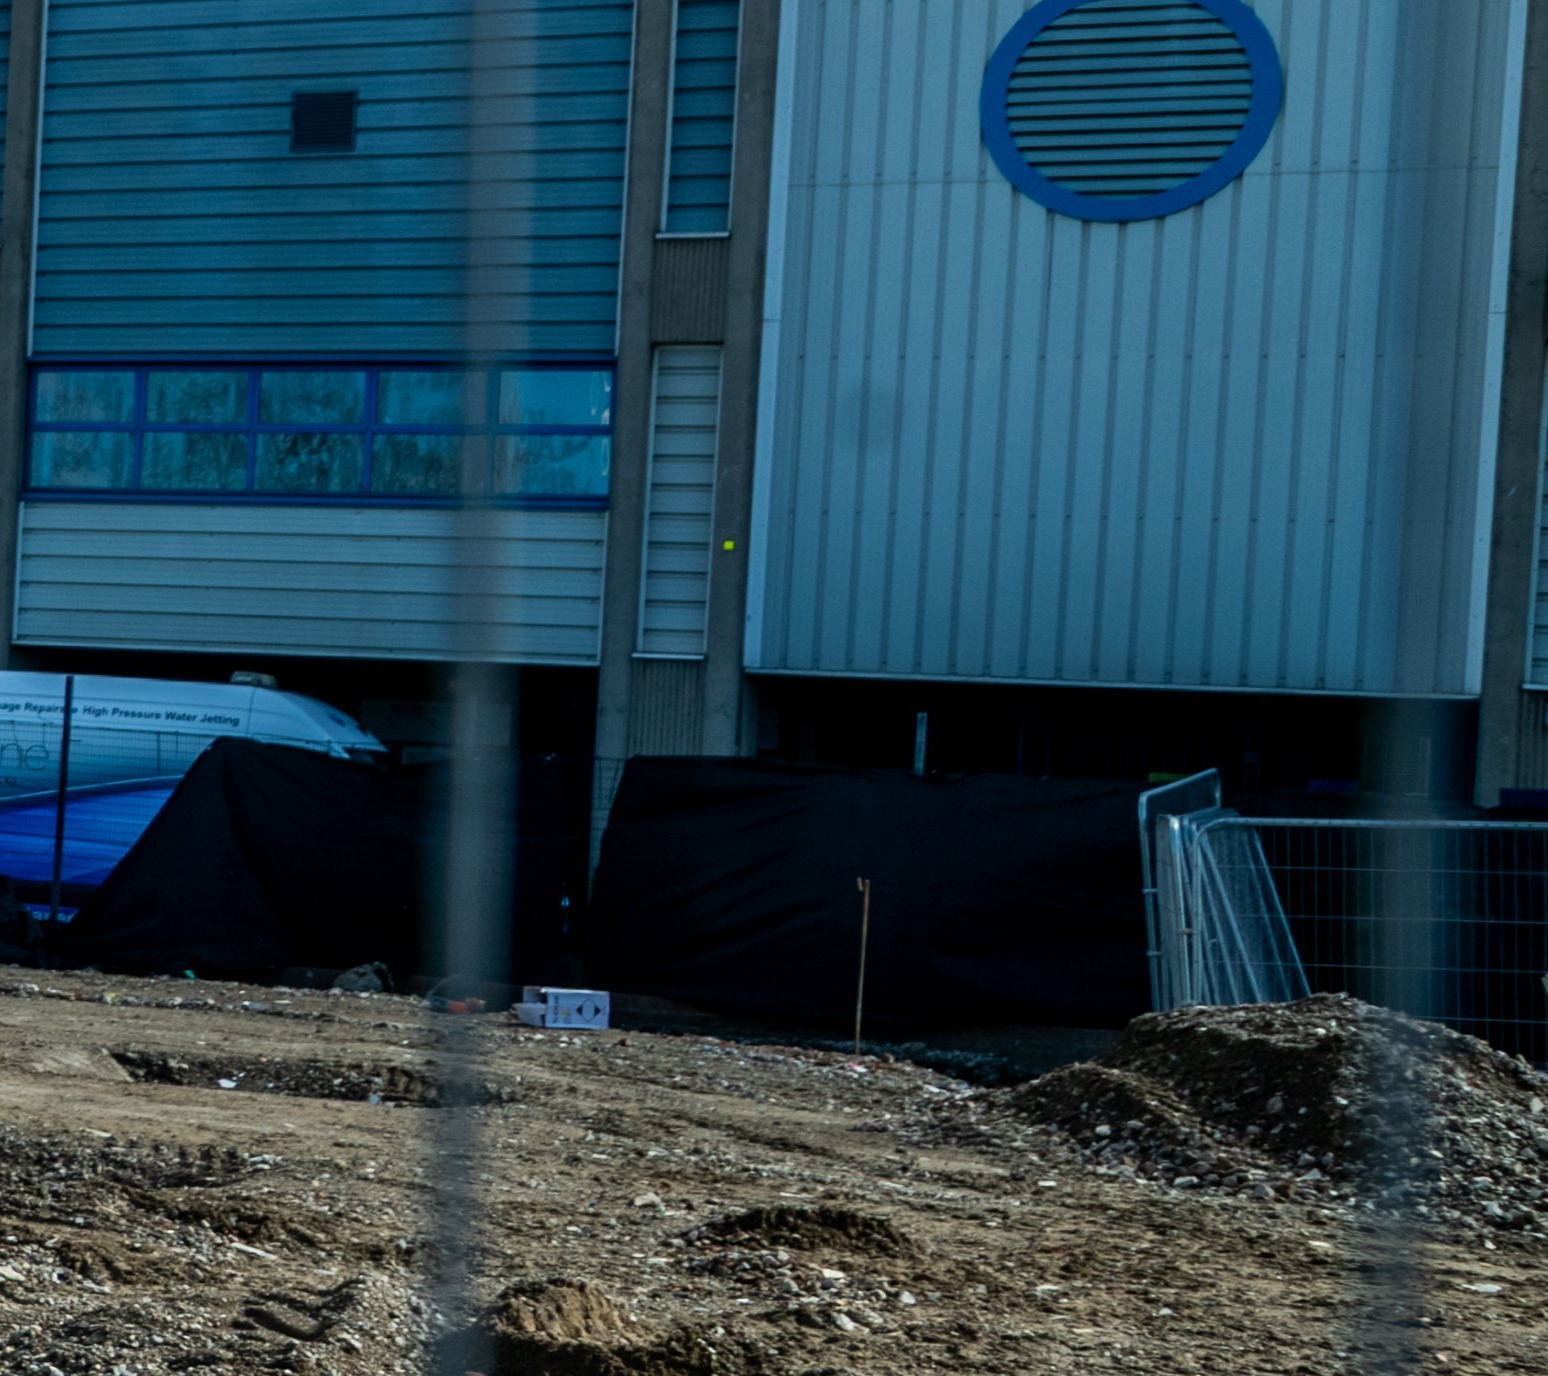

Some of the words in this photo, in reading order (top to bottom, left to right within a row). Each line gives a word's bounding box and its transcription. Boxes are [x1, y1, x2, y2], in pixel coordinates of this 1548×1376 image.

[24, 702, 66, 714] Repairs
[82, 705, 108, 718] High
[112, 707, 162, 720] Pressure
[164, 710, 198, 723] Water
[200, 713, 240, 727] Jetting
